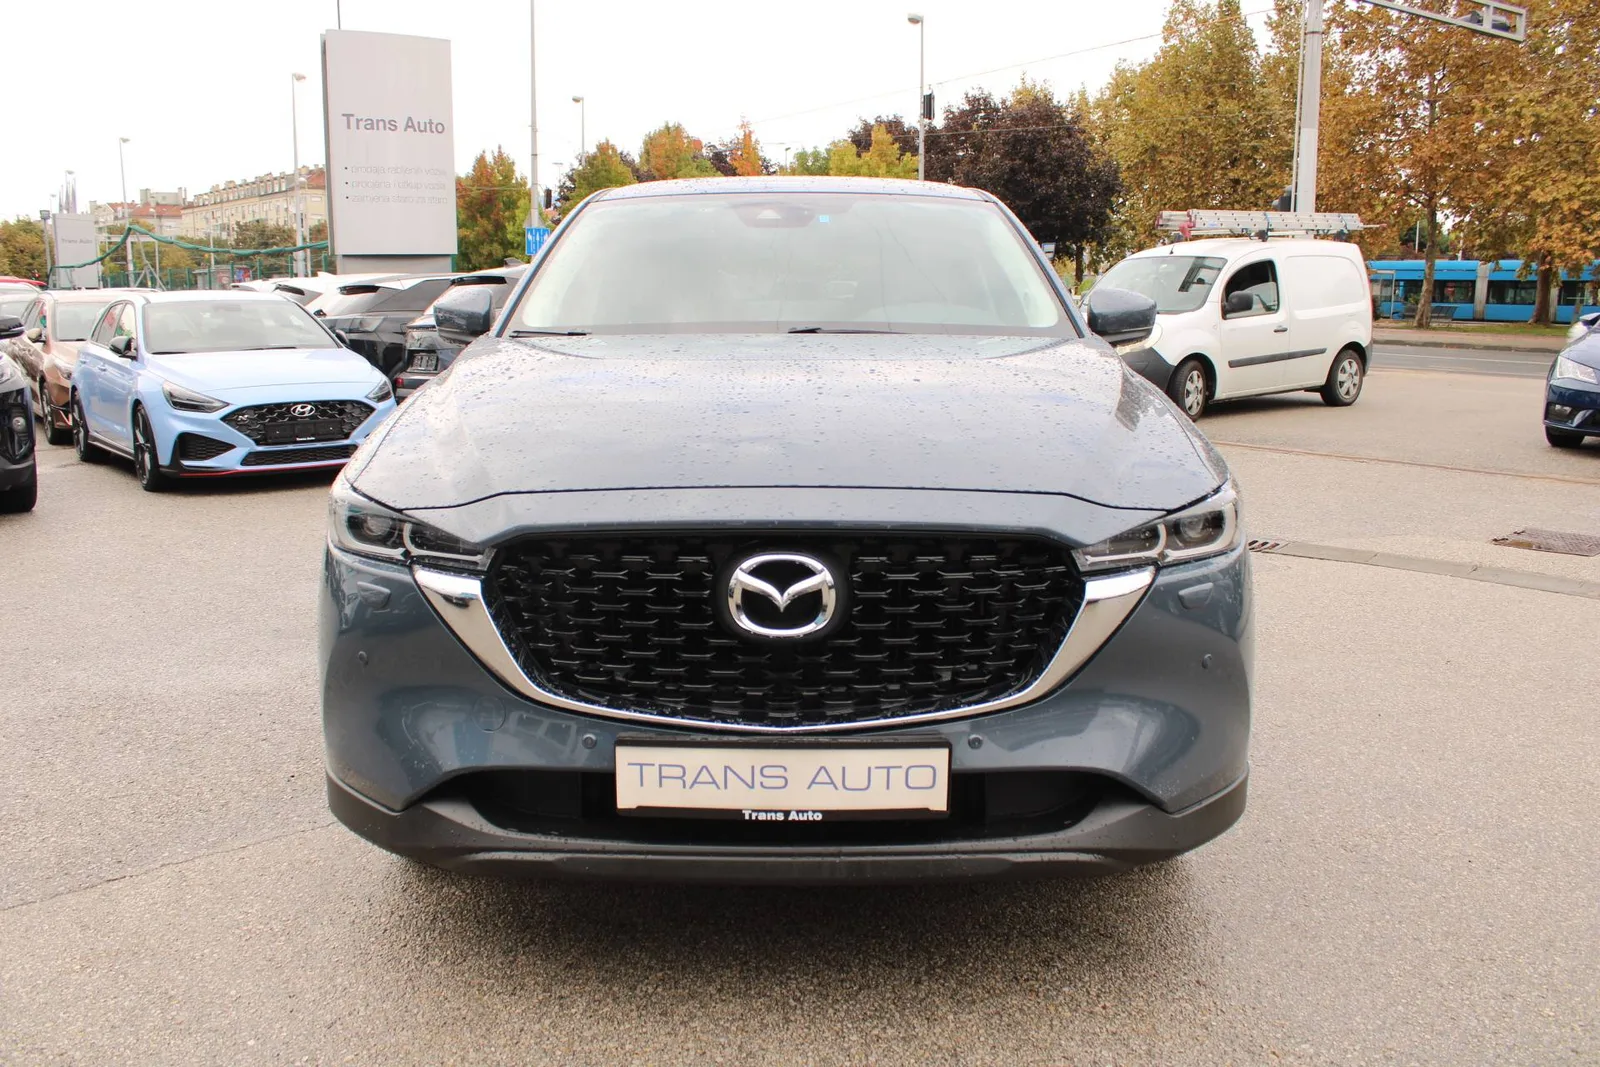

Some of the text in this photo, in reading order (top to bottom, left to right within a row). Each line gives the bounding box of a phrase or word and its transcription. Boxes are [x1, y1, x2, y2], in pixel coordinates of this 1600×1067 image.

[341, 113, 446, 134] Trans Auto
[627, 762, 937, 791] TRANS AUTO
[742, 810, 823, 821] Trans Auto
